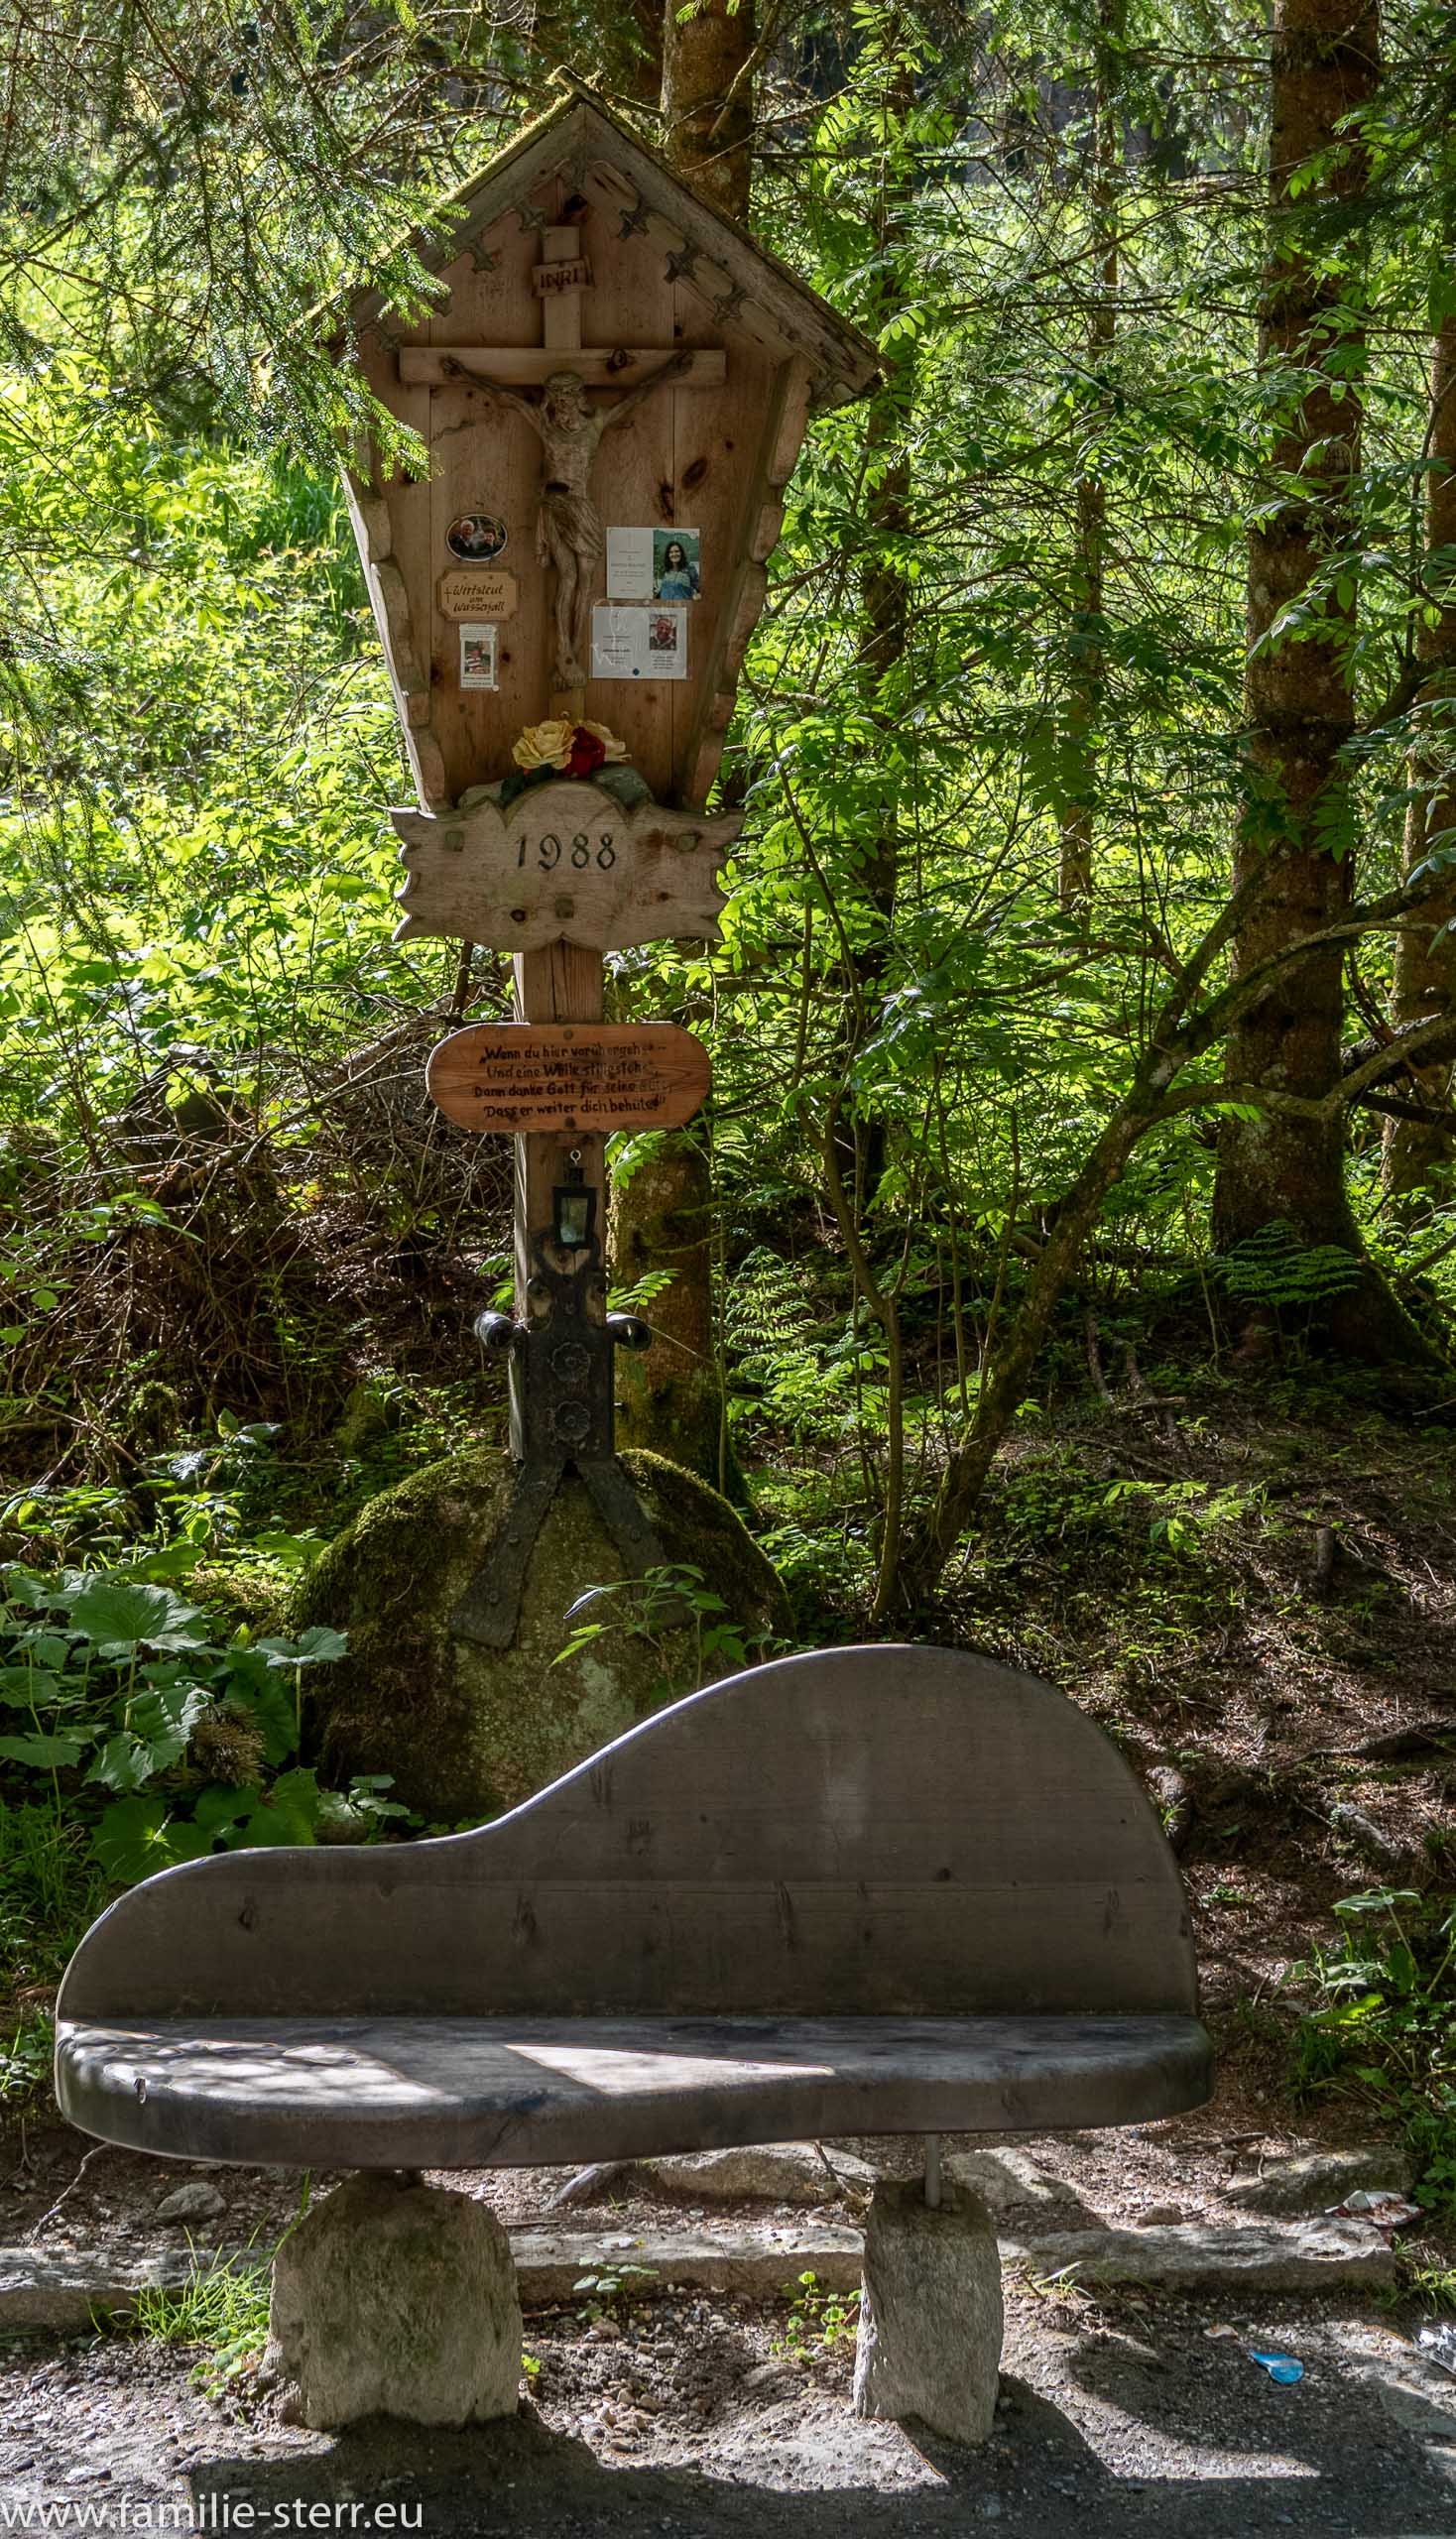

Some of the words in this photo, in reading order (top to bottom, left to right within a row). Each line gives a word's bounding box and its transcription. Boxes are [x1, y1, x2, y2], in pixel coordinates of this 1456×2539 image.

[541, 268, 578, 288] INRI
[517, 833, 616, 870] 1988
[525, 1044, 539, 1059] du
[543, 1044, 568, 1056] hier
[486, 1066, 514, 1079] Und
[517, 1065, 541, 1078] eine
[474, 1086, 506, 1097] Dann
[509, 1085, 543, 1097] danke
[546, 1082, 575, 1095] Gott
[580, 1079, 599, 1098] für
[521, 1106, 534, 1116] er
[537, 1102, 577, 1114] weiter
[580, 1100, 607, 1113] dich
